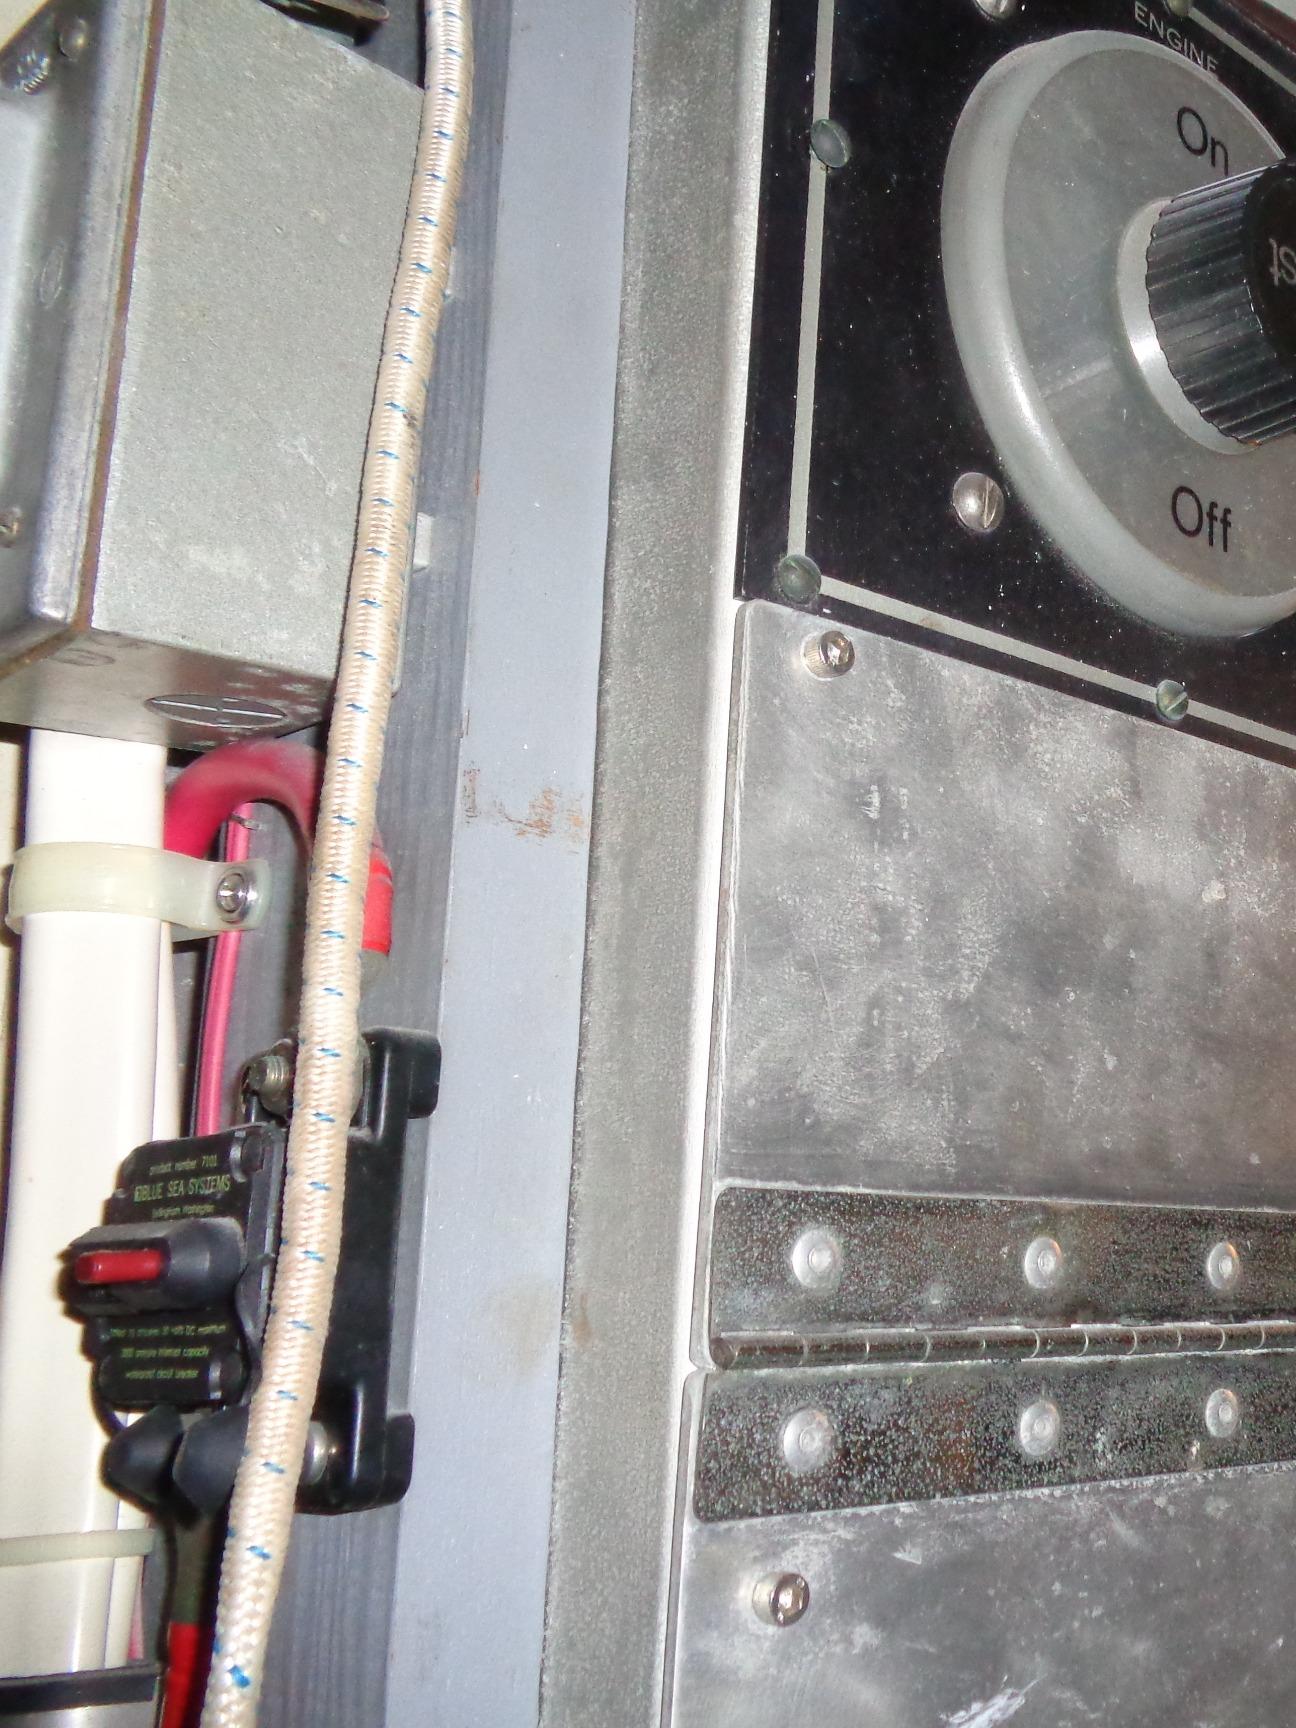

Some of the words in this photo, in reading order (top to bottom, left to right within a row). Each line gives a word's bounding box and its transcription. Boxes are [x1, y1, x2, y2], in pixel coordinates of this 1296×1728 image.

[1134, 1, 1219, 77] ENGINE
[1176, 105, 1229, 177] On
[1171, 484, 1233, 554] Off
[167, 1179, 185, 1198] SEA
[187, 1174, 231, 1196] SYSTEMS
